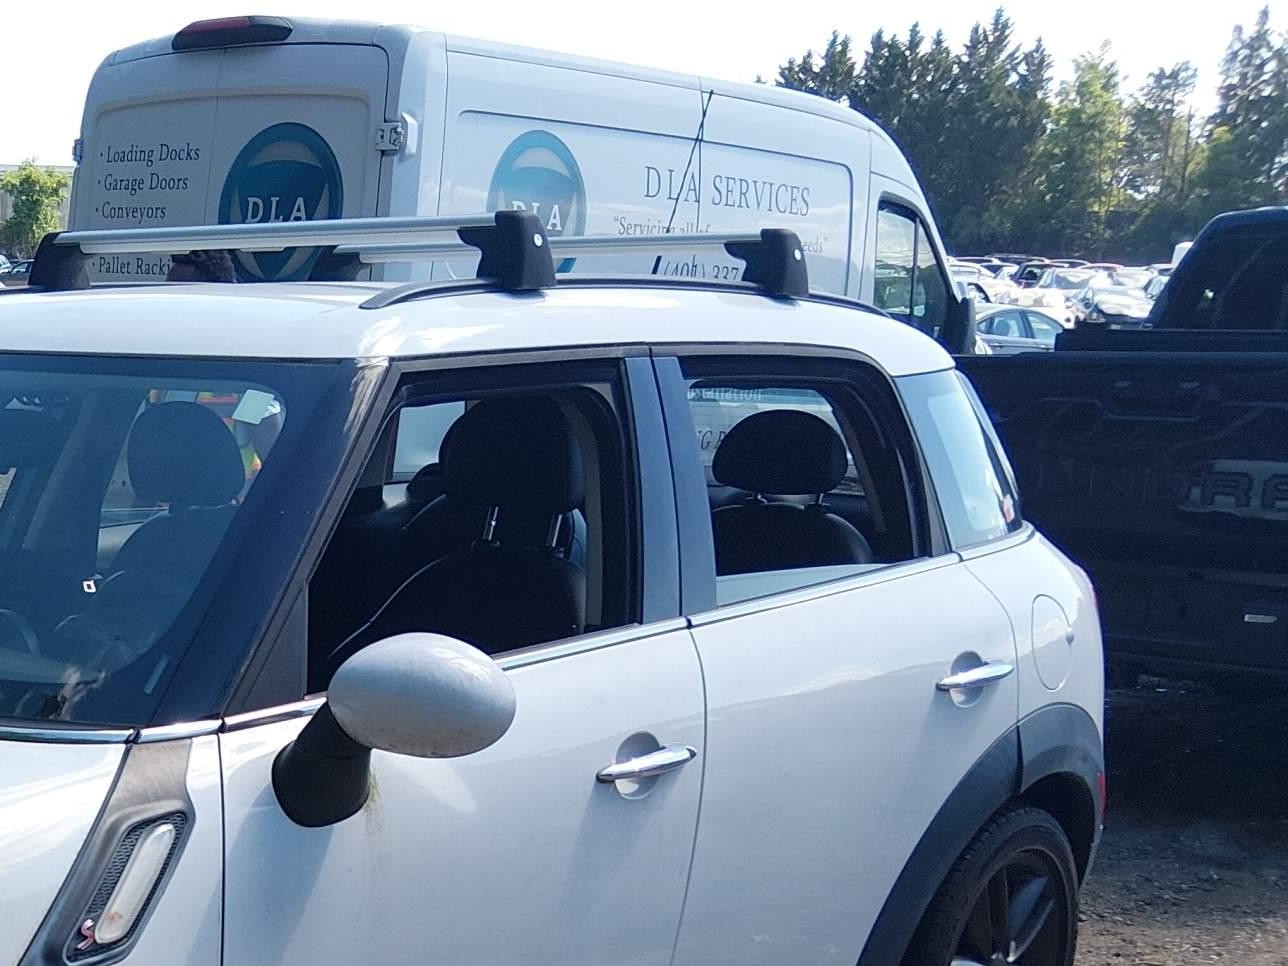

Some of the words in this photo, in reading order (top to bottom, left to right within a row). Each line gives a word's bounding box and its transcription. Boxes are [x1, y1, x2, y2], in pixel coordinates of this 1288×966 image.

[106, 143, 154, 167] Loading
[158, 142, 200, 162] Docks
[104, 173, 145, 195] Garage
[149, 172, 189, 190] Doors
[643, 166, 700, 203] DLA
[711, 174, 811, 217] SERVICES
[101, 201, 166, 224] Conveyors
[245, 196, 307, 223] DLA
[98, 256, 131, 274] Pallet
[135, 256, 171, 275] Racki
